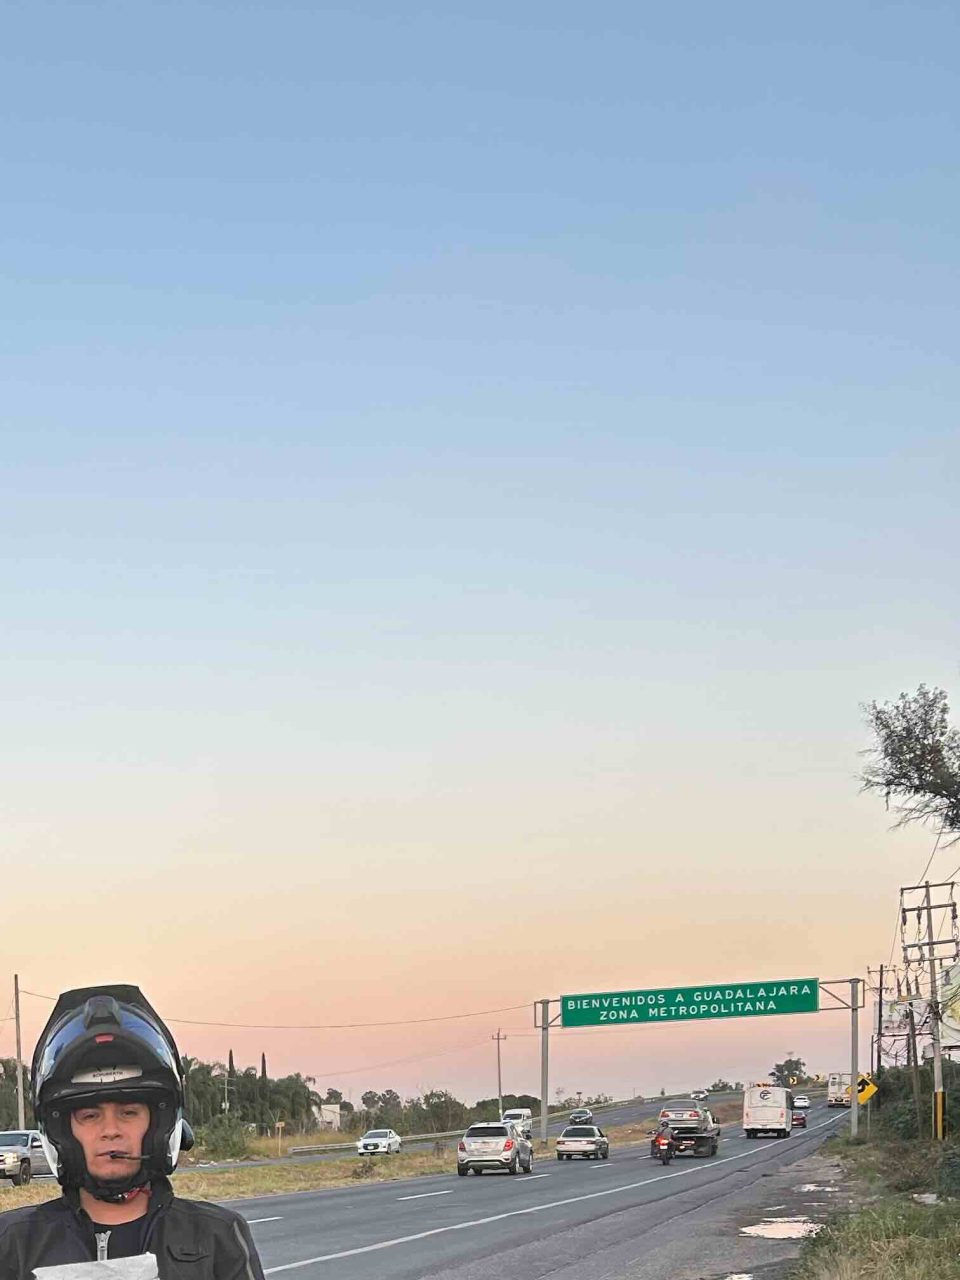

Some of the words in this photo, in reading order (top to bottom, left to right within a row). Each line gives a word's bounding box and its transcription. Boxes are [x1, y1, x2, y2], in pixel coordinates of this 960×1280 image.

[567, 994, 666, 1010] BIENVENIDOS
[675, 993, 685, 1003] A
[693, 985, 811, 1001] GUADALAJARA
[600, 1009, 639, 1021] ZONA
[648, 1000, 777, 1017] METROPOLITANA
